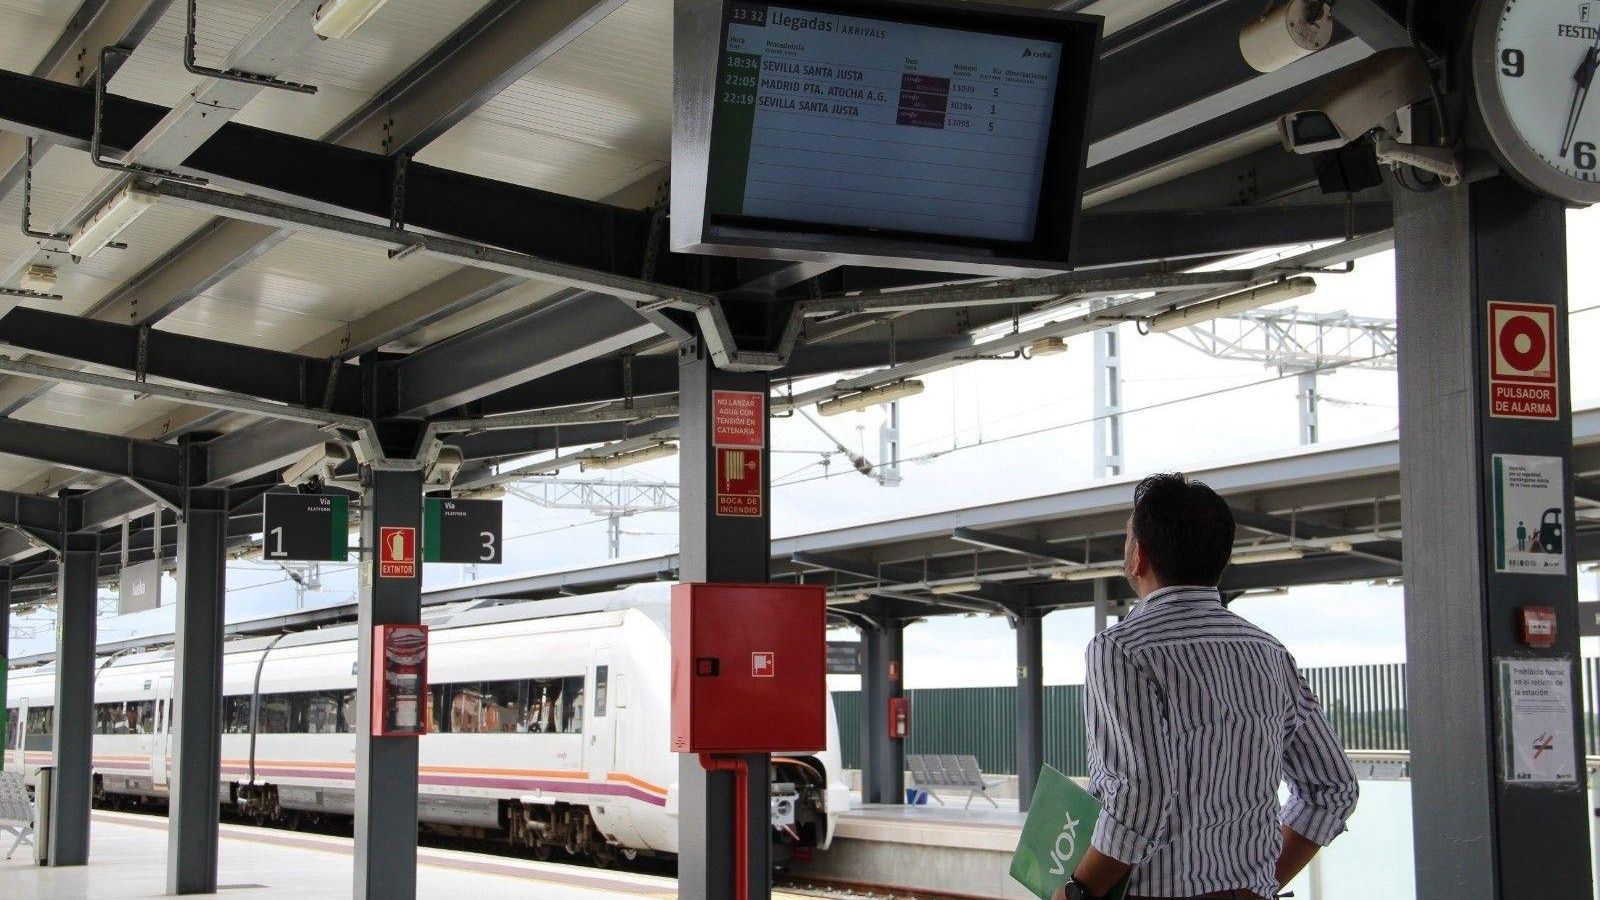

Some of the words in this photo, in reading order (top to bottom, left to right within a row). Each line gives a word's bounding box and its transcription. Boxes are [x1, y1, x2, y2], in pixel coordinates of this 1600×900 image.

[772, 11, 832, 32] Llegadas
[841, 25, 886, 39] ARRIVALS
[766, 40, 805, 51] Procedencia
[1501, 48, 1525, 78] 9
[728, 57, 759, 69] 18:34
[763, 60, 800, 74] SEVILLA
[803, 65, 833, 78] SANTA
[836, 69, 864, 81] JUSTA
[726, 74, 756, 87] 22:05
[761, 79, 800, 92] MADRID
[803, 84, 824, 96] PTA.
[827, 87, 864, 100] ATOCHA
[866, 91, 888, 103] A.G.
[993, 87, 999, 98] 5
[724, 92, 754, 105] 22:19
[758, 95, 795, 109] SEVILLA
[798, 100, 829, 113] SANTA
[831, 105, 859, 117] JUSTA
[990, 104, 996, 115] 1
[987, 122, 994, 132] 5
[1573, 141, 1597, 171] 6
[1497, 387, 1550, 400] PULSADOR
[717, 398, 728, 407] NO
[728, 399, 755, 408] LANZAR
[1495, 401, 1509, 412] DE
[1511, 402, 1552, 414] ALARMA
[719, 408, 739, 416] AGUA
[739, 409, 754, 417] CON
[716, 416, 745, 425] TENSIÓN
[746, 418, 756, 426] EN
[717, 426, 755, 435] CATENARIA
[319, 497, 331, 505] Vía
[720, 497, 742, 505] BOCA
[747, 497, 757, 506] DE
[720, 506, 758, 514] INCENDIO
[270, 526, 288, 557] 1
[479, 531, 495, 561] 3
[382, 565, 413, 575] EXTINTOR
[1049, 811, 1080, 875] VOX
